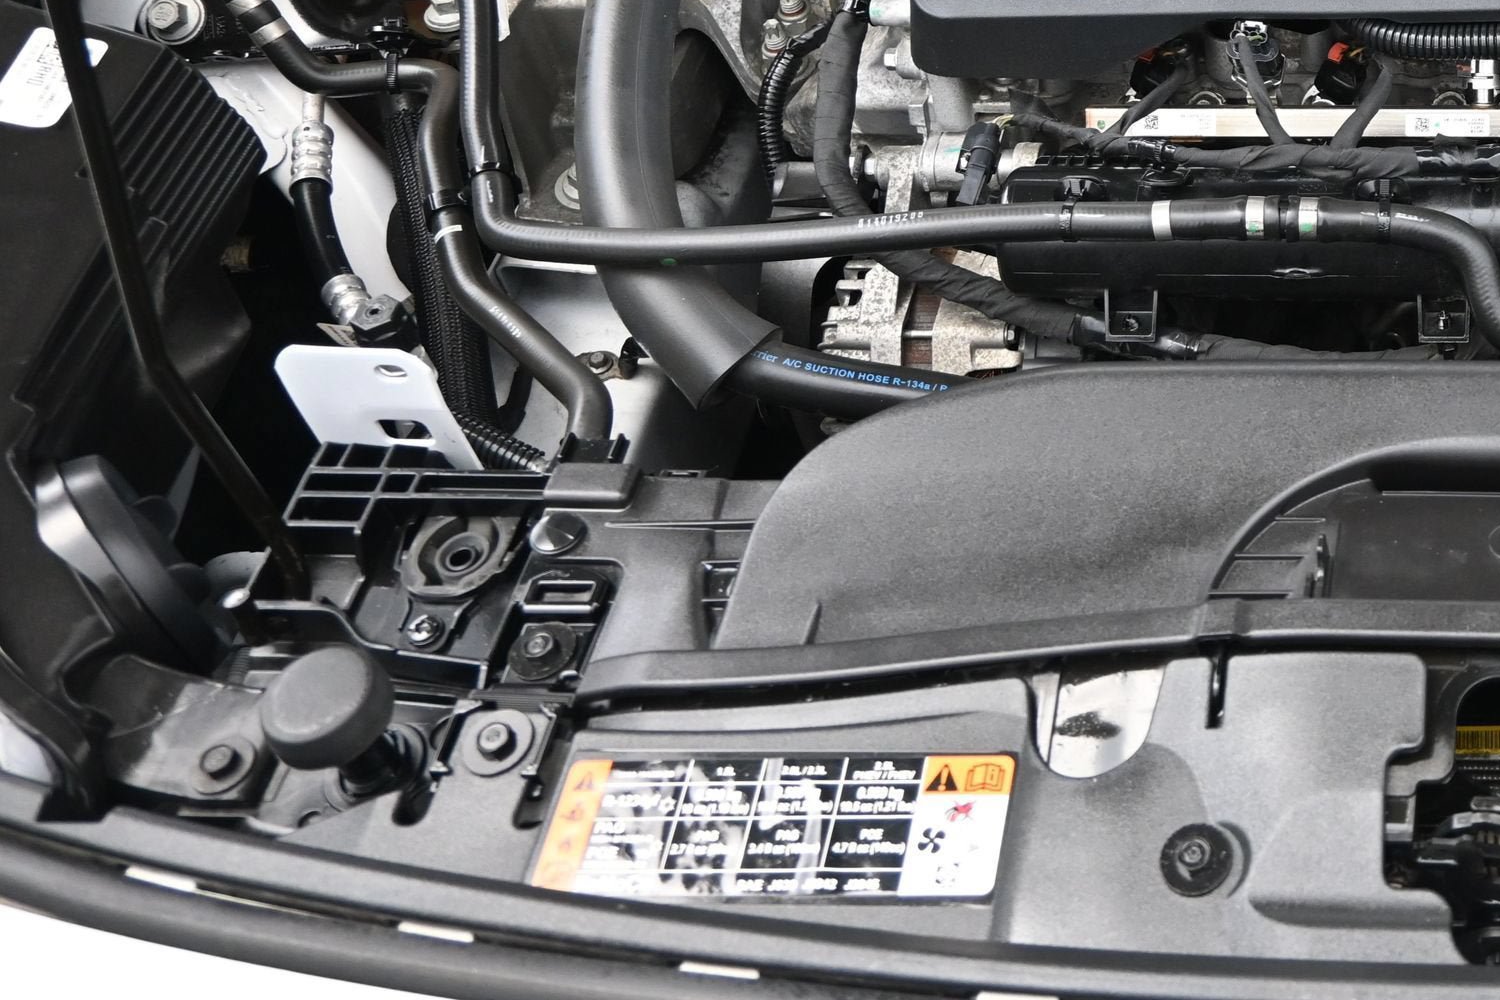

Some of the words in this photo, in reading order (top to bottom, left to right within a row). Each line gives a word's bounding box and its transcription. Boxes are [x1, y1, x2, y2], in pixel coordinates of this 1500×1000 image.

[782, 358, 802, 368] A/C
[804, 363, 855, 379] SUCTION
[857, 372, 890, 384] HOSE
[892, 377, 931, 390] R-134a
